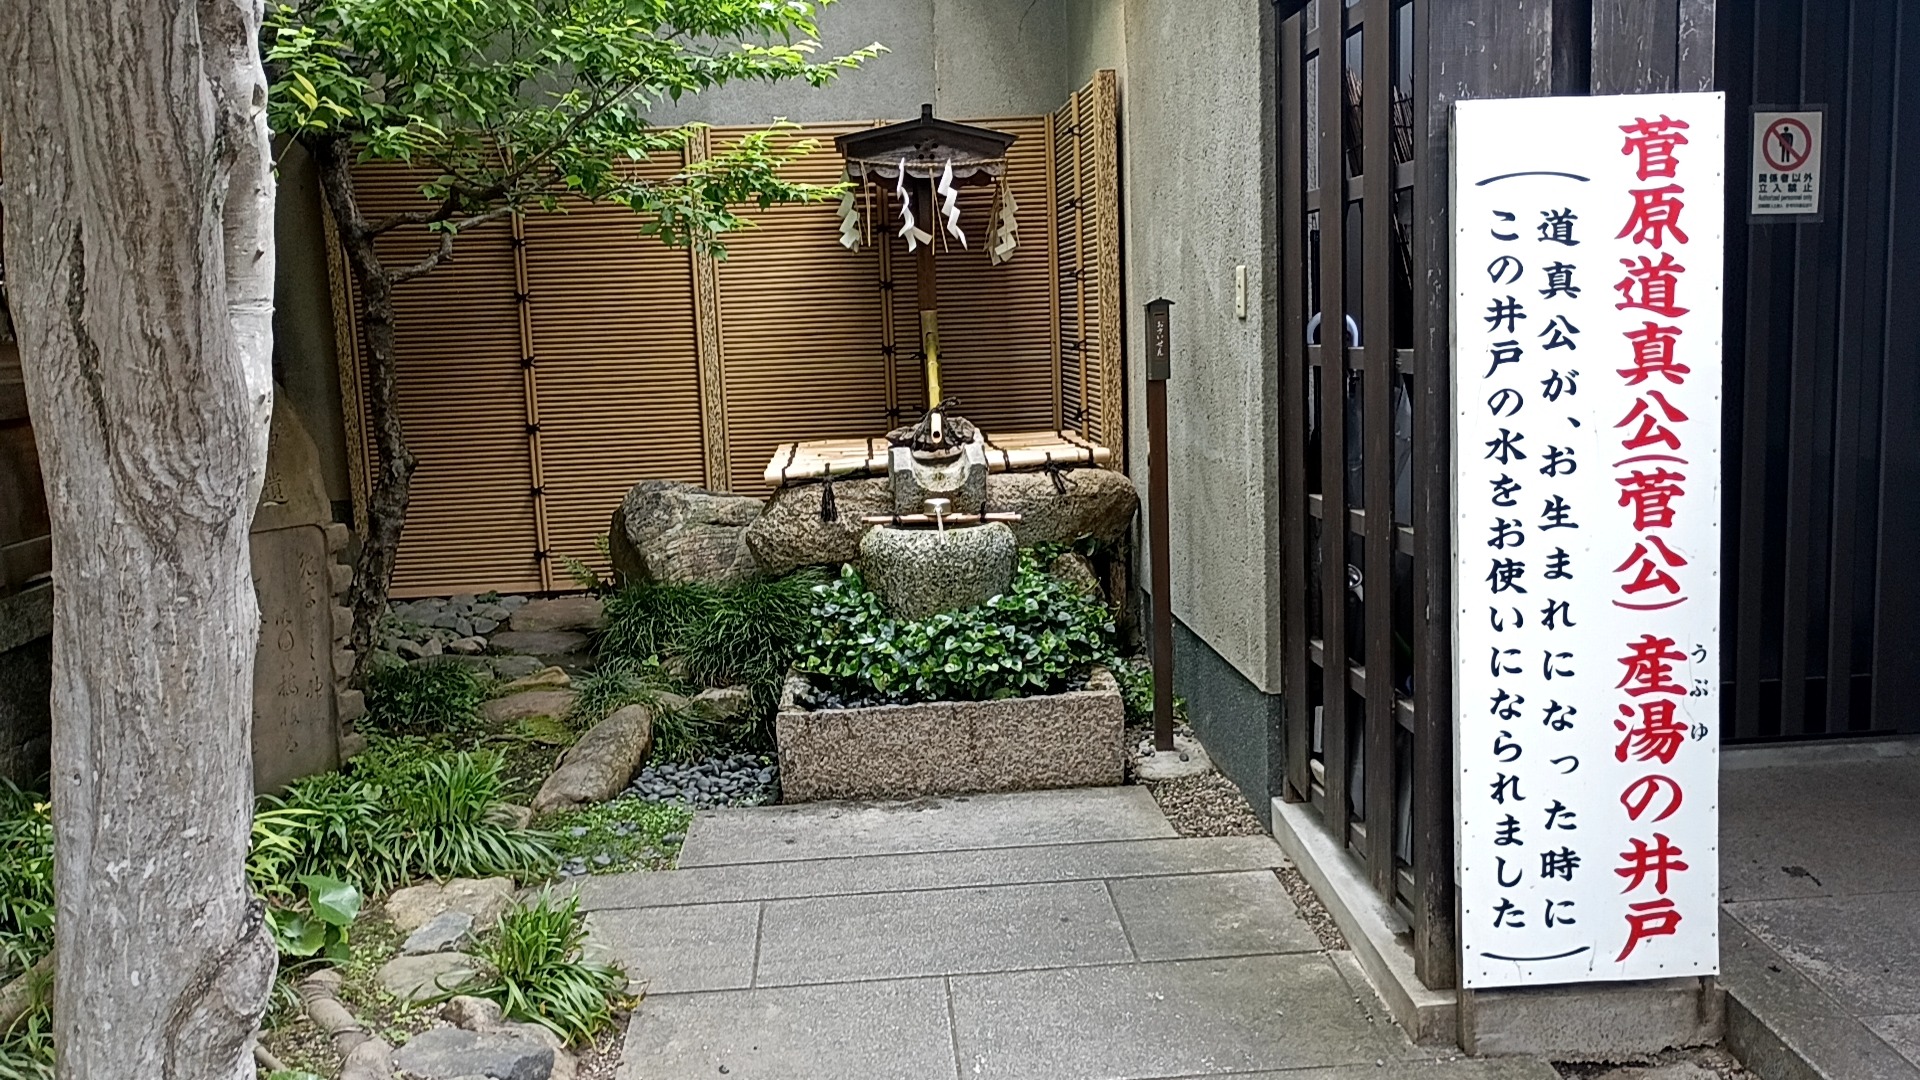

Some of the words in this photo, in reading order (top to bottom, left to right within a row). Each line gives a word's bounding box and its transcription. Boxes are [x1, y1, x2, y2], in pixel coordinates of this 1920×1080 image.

[1758, 173, 1812, 183] 関係者以外
[1758, 183, 1812, 193] 立入禁止
[1155, 320, 1164, 357] おさいせん
[1689, 643, 1709, 742] うぶゆ
